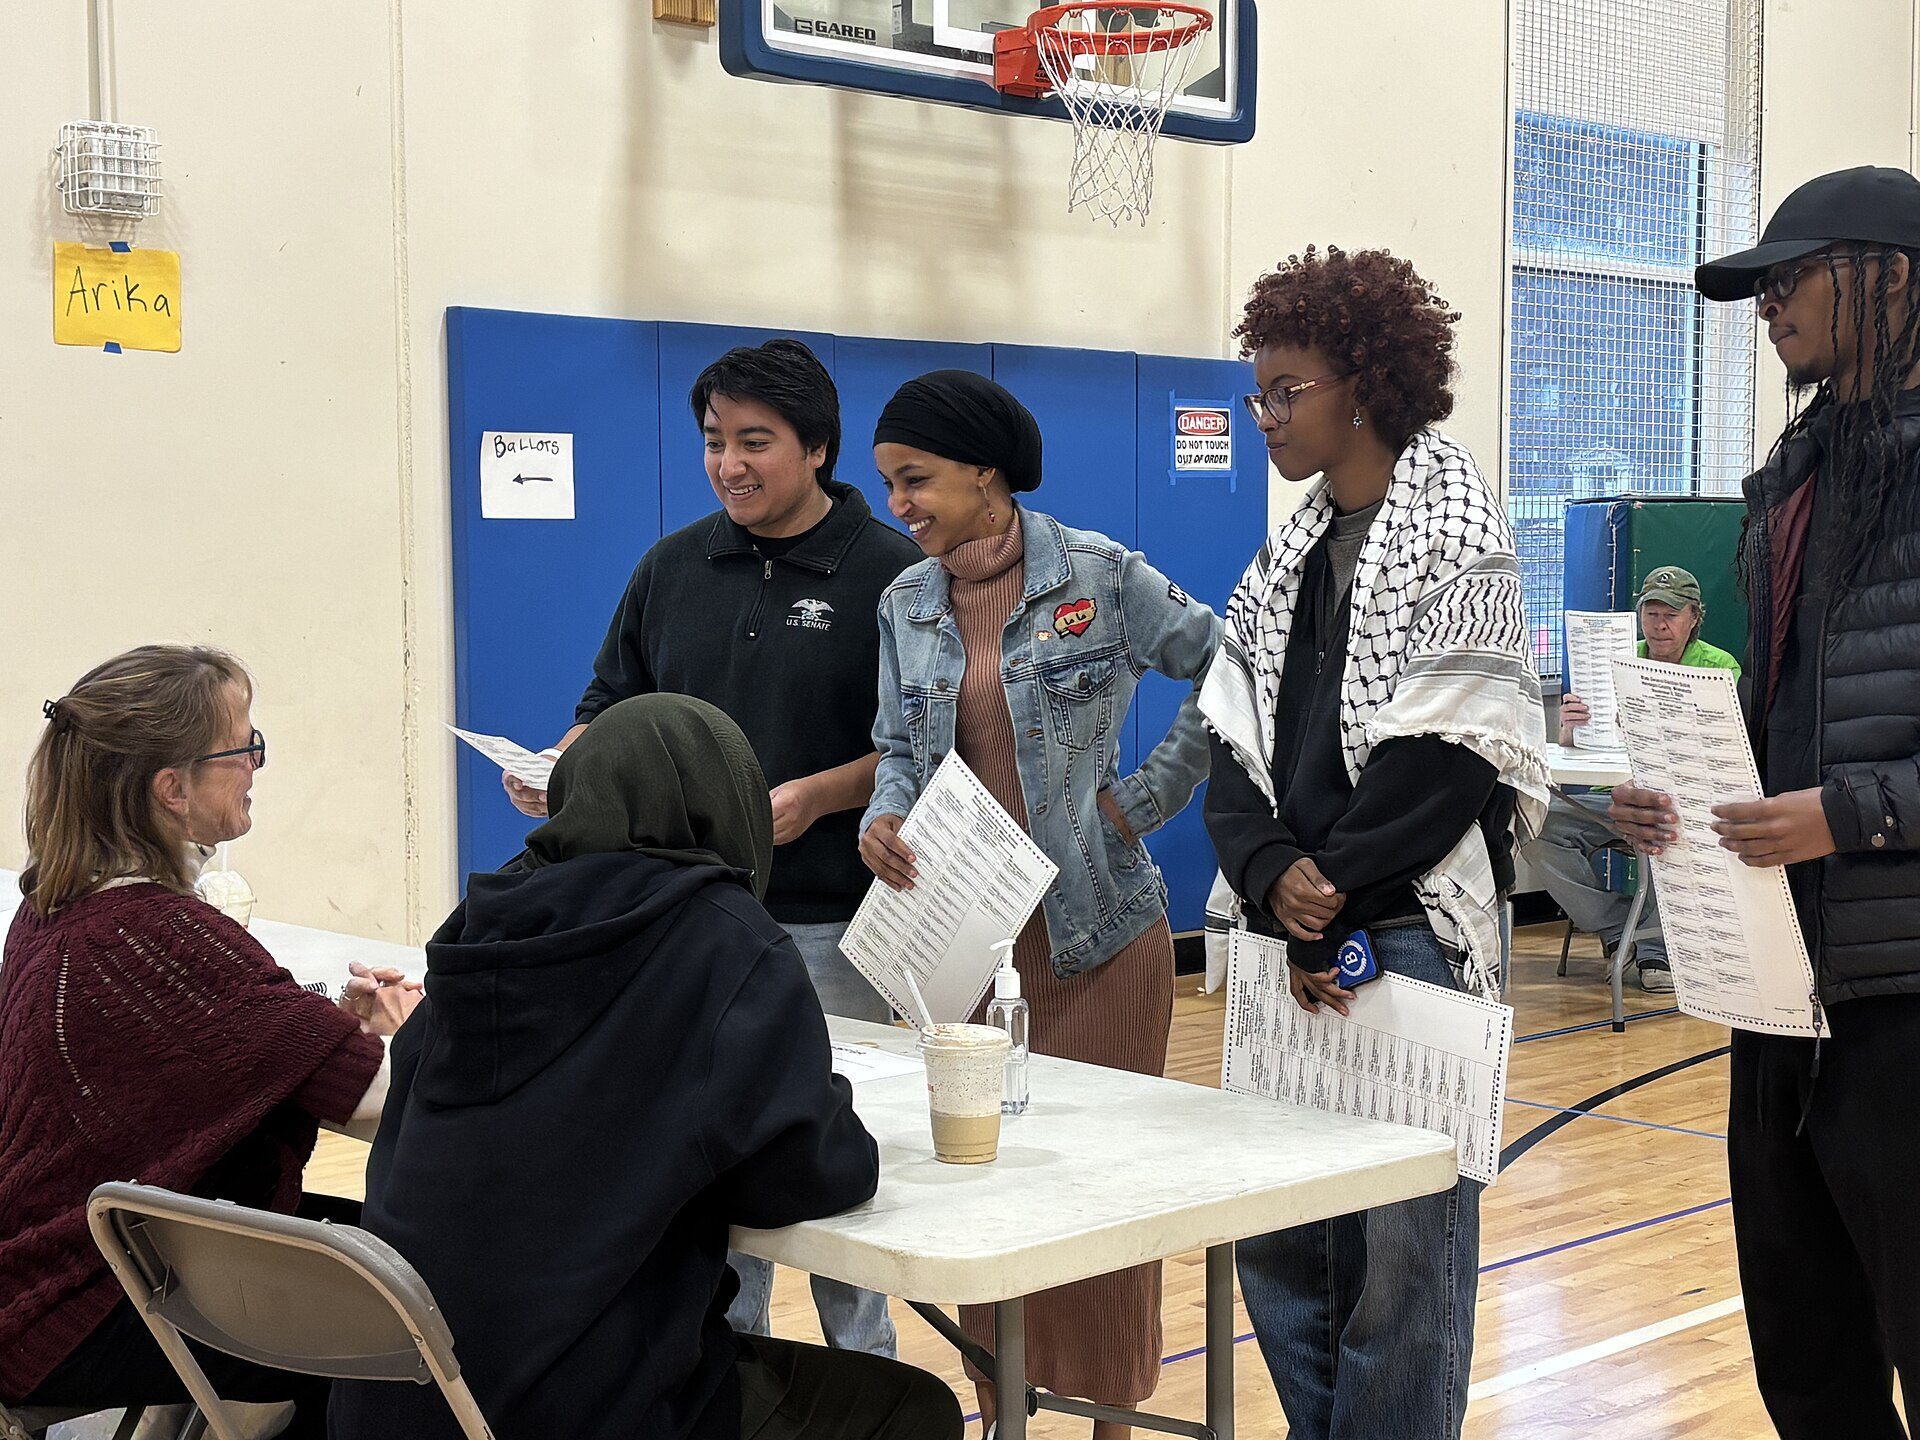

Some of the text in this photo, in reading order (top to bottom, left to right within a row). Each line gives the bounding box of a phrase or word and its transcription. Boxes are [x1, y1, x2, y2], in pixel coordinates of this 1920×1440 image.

[815, 20, 877, 41] GARED
[66, 265, 171, 318] Arika
[1181, 416, 1224, 430] DANGER
[1176, 440, 1229, 450] DO NOT TOUCH
[1177, 454, 1228, 464] OUT OF ORDER
[801, 619, 831, 632] SENATE
[1344, 950, 1359, 965] B
